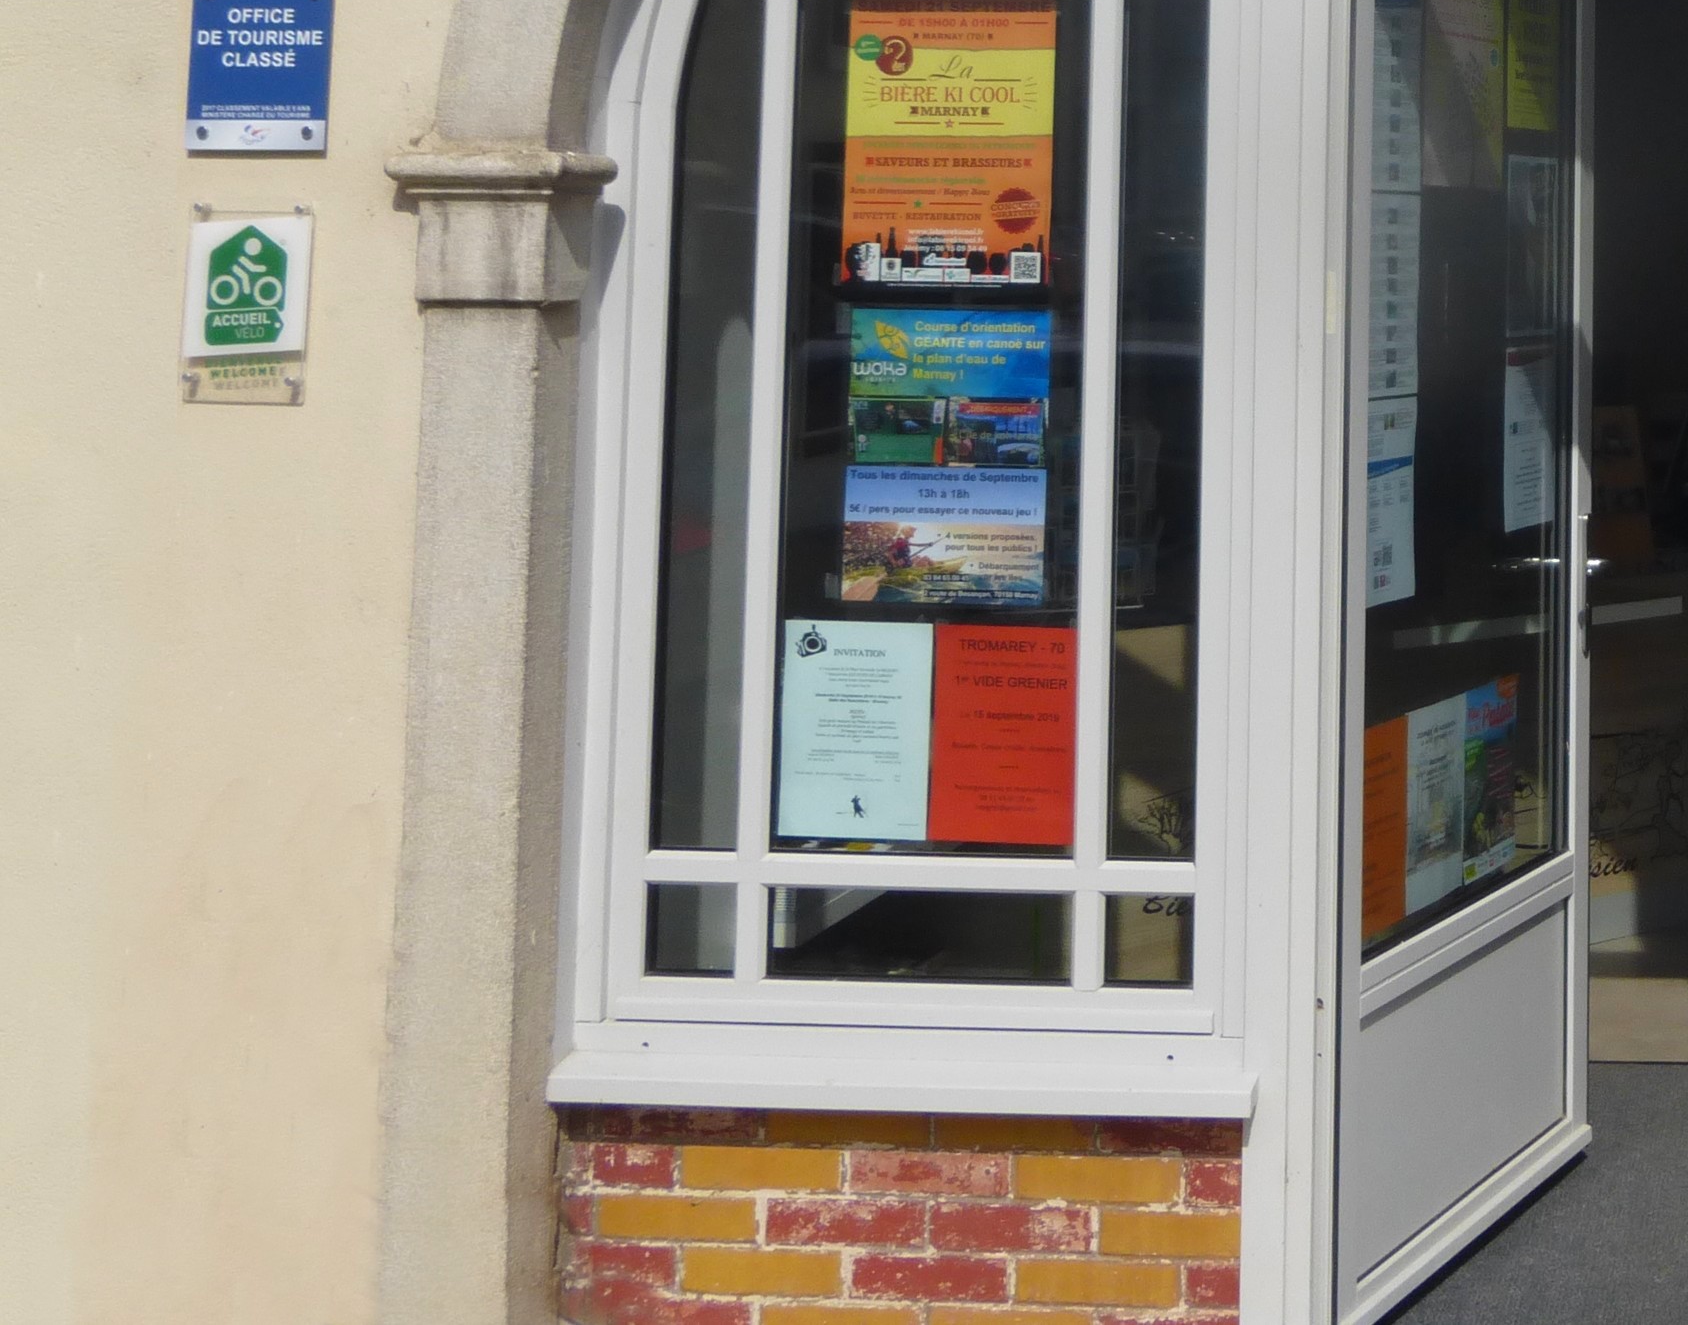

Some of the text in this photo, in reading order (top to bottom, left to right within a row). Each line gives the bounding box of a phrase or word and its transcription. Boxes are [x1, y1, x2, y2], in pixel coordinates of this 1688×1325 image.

[227, 8, 296, 24] OFFICE
[197, 29, 324, 46] DE TOURISME
[221, 48, 296, 68] CLASSÉ
[929, 55, 974, 79] La
[879, 83, 1021, 103] BIÈRE KI COOL
[921, 106, 979, 117] MARNAY
[875, 157, 1022, 168] SAVEURS ET BRASSEURS
[212, 312, 271, 327] ACCUEIL
[915, 321, 1036, 333] Course d'orientation
[968, 340, 983, 348] en
[1025, 340, 1046, 349] sur
[991, 354, 1006, 364] de
[850, 469, 1039, 484] Tous les dimanches de Septembre
[918, 489, 936, 499] 13h
[951, 489, 970, 499] 18h
[868, 506, 890, 515] pers
[892, 506, 914, 515] pour
[917, 507, 955, 516] essayer
[972, 507, 1014, 516] nouveau
[834, 648, 887, 657] INVITATION
[959, 639, 1037, 653] TROMAREY
[1050, 642, 1065, 654] 70
[973, 676, 1003, 687] VIDE
[1008, 677, 1067, 690] GRENIER
